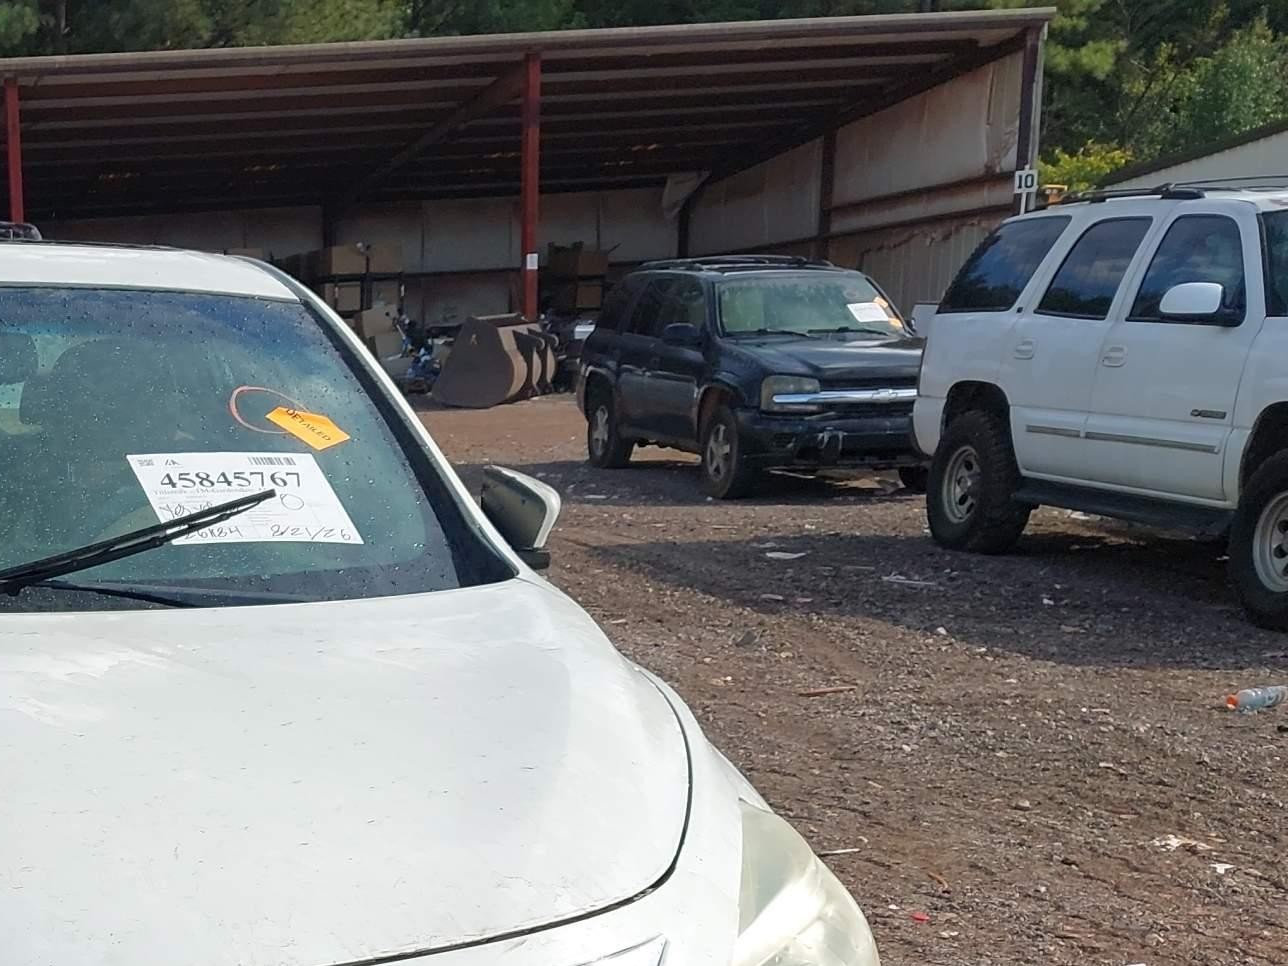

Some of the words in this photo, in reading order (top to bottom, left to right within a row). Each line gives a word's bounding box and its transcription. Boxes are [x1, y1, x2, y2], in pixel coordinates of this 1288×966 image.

[1017, 173, 1035, 189] 10
[285, 409, 331, 440] DETAILED
[160, 471, 301, 489] 45845767
